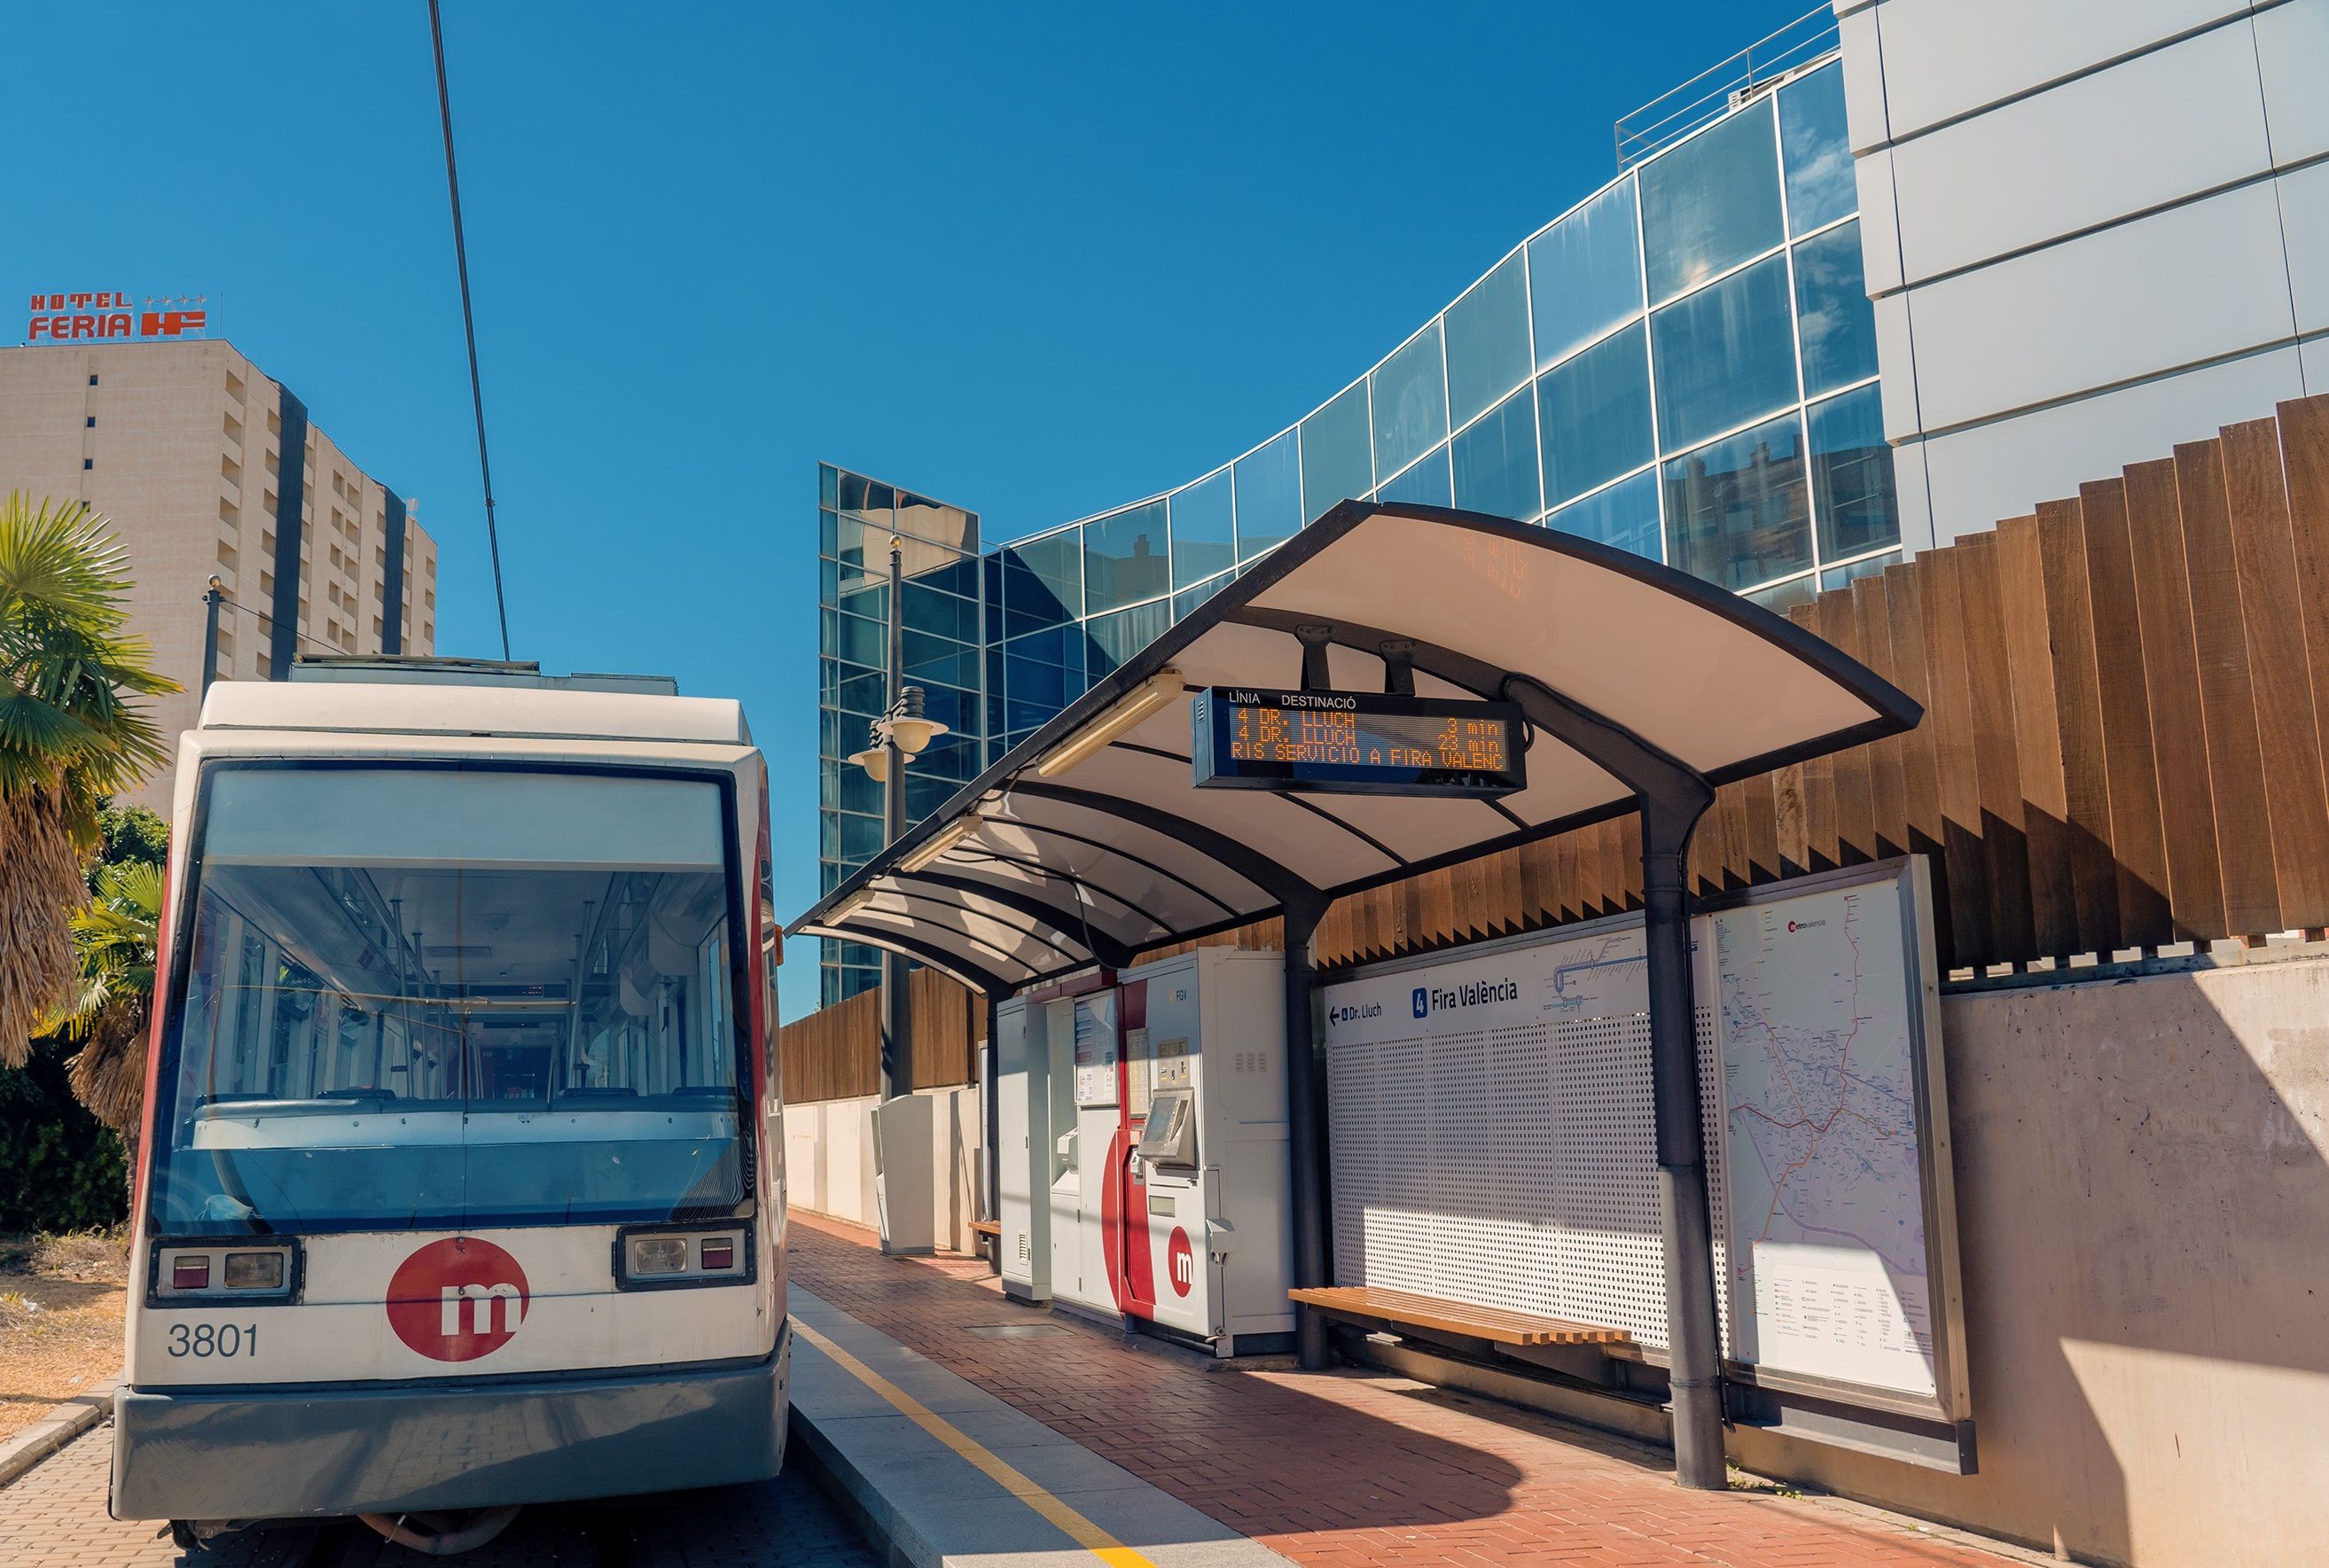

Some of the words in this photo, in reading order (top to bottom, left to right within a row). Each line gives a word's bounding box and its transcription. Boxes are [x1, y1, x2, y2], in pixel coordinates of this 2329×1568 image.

[31, 292, 132, 310] HOTEL
[29, 313, 132, 340] FERIA
[141, 311, 206, 336] HF
[1229, 690, 1261, 705] LÍNIA
[1282, 695, 1356, 709] DESTINACIÓ
[1238, 708, 1248, 722] 4
[1259, 708, 1289, 725] DR.
[1301, 710, 1356, 729] LLUCH
[1447, 717, 1458, 734] 3
[1467, 719, 1498, 736] min
[1239, 724, 1249, 741] 4
[1260, 726, 1290, 743] DR.
[1302, 727, 1356, 746] LLUCH
[1438, 734, 1458, 751] 23
[1468, 737, 1499, 753] min
[1231, 742, 1264, 759] RIS
[1275, 744, 1360, 764] SERVICIO
[1370, 748, 1381, 765] A
[1390, 748, 1432, 767] FIRA
[1442, 752, 1503, 769] VALENC
[1176, 989, 1187, 1002] FGV
[1416, 992, 1425, 1014] 4
[1431, 988, 1457, 1010] Fira
[1458, 977, 1518, 1007] València
[1349, 1006, 1360, 1020] Dr.
[1362, 1002, 1382, 1018] Lluch
[1176, 1251, 1192, 1285] m
[441, 1283, 522, 1337] m
[167, 1323, 258, 1358] 3801
